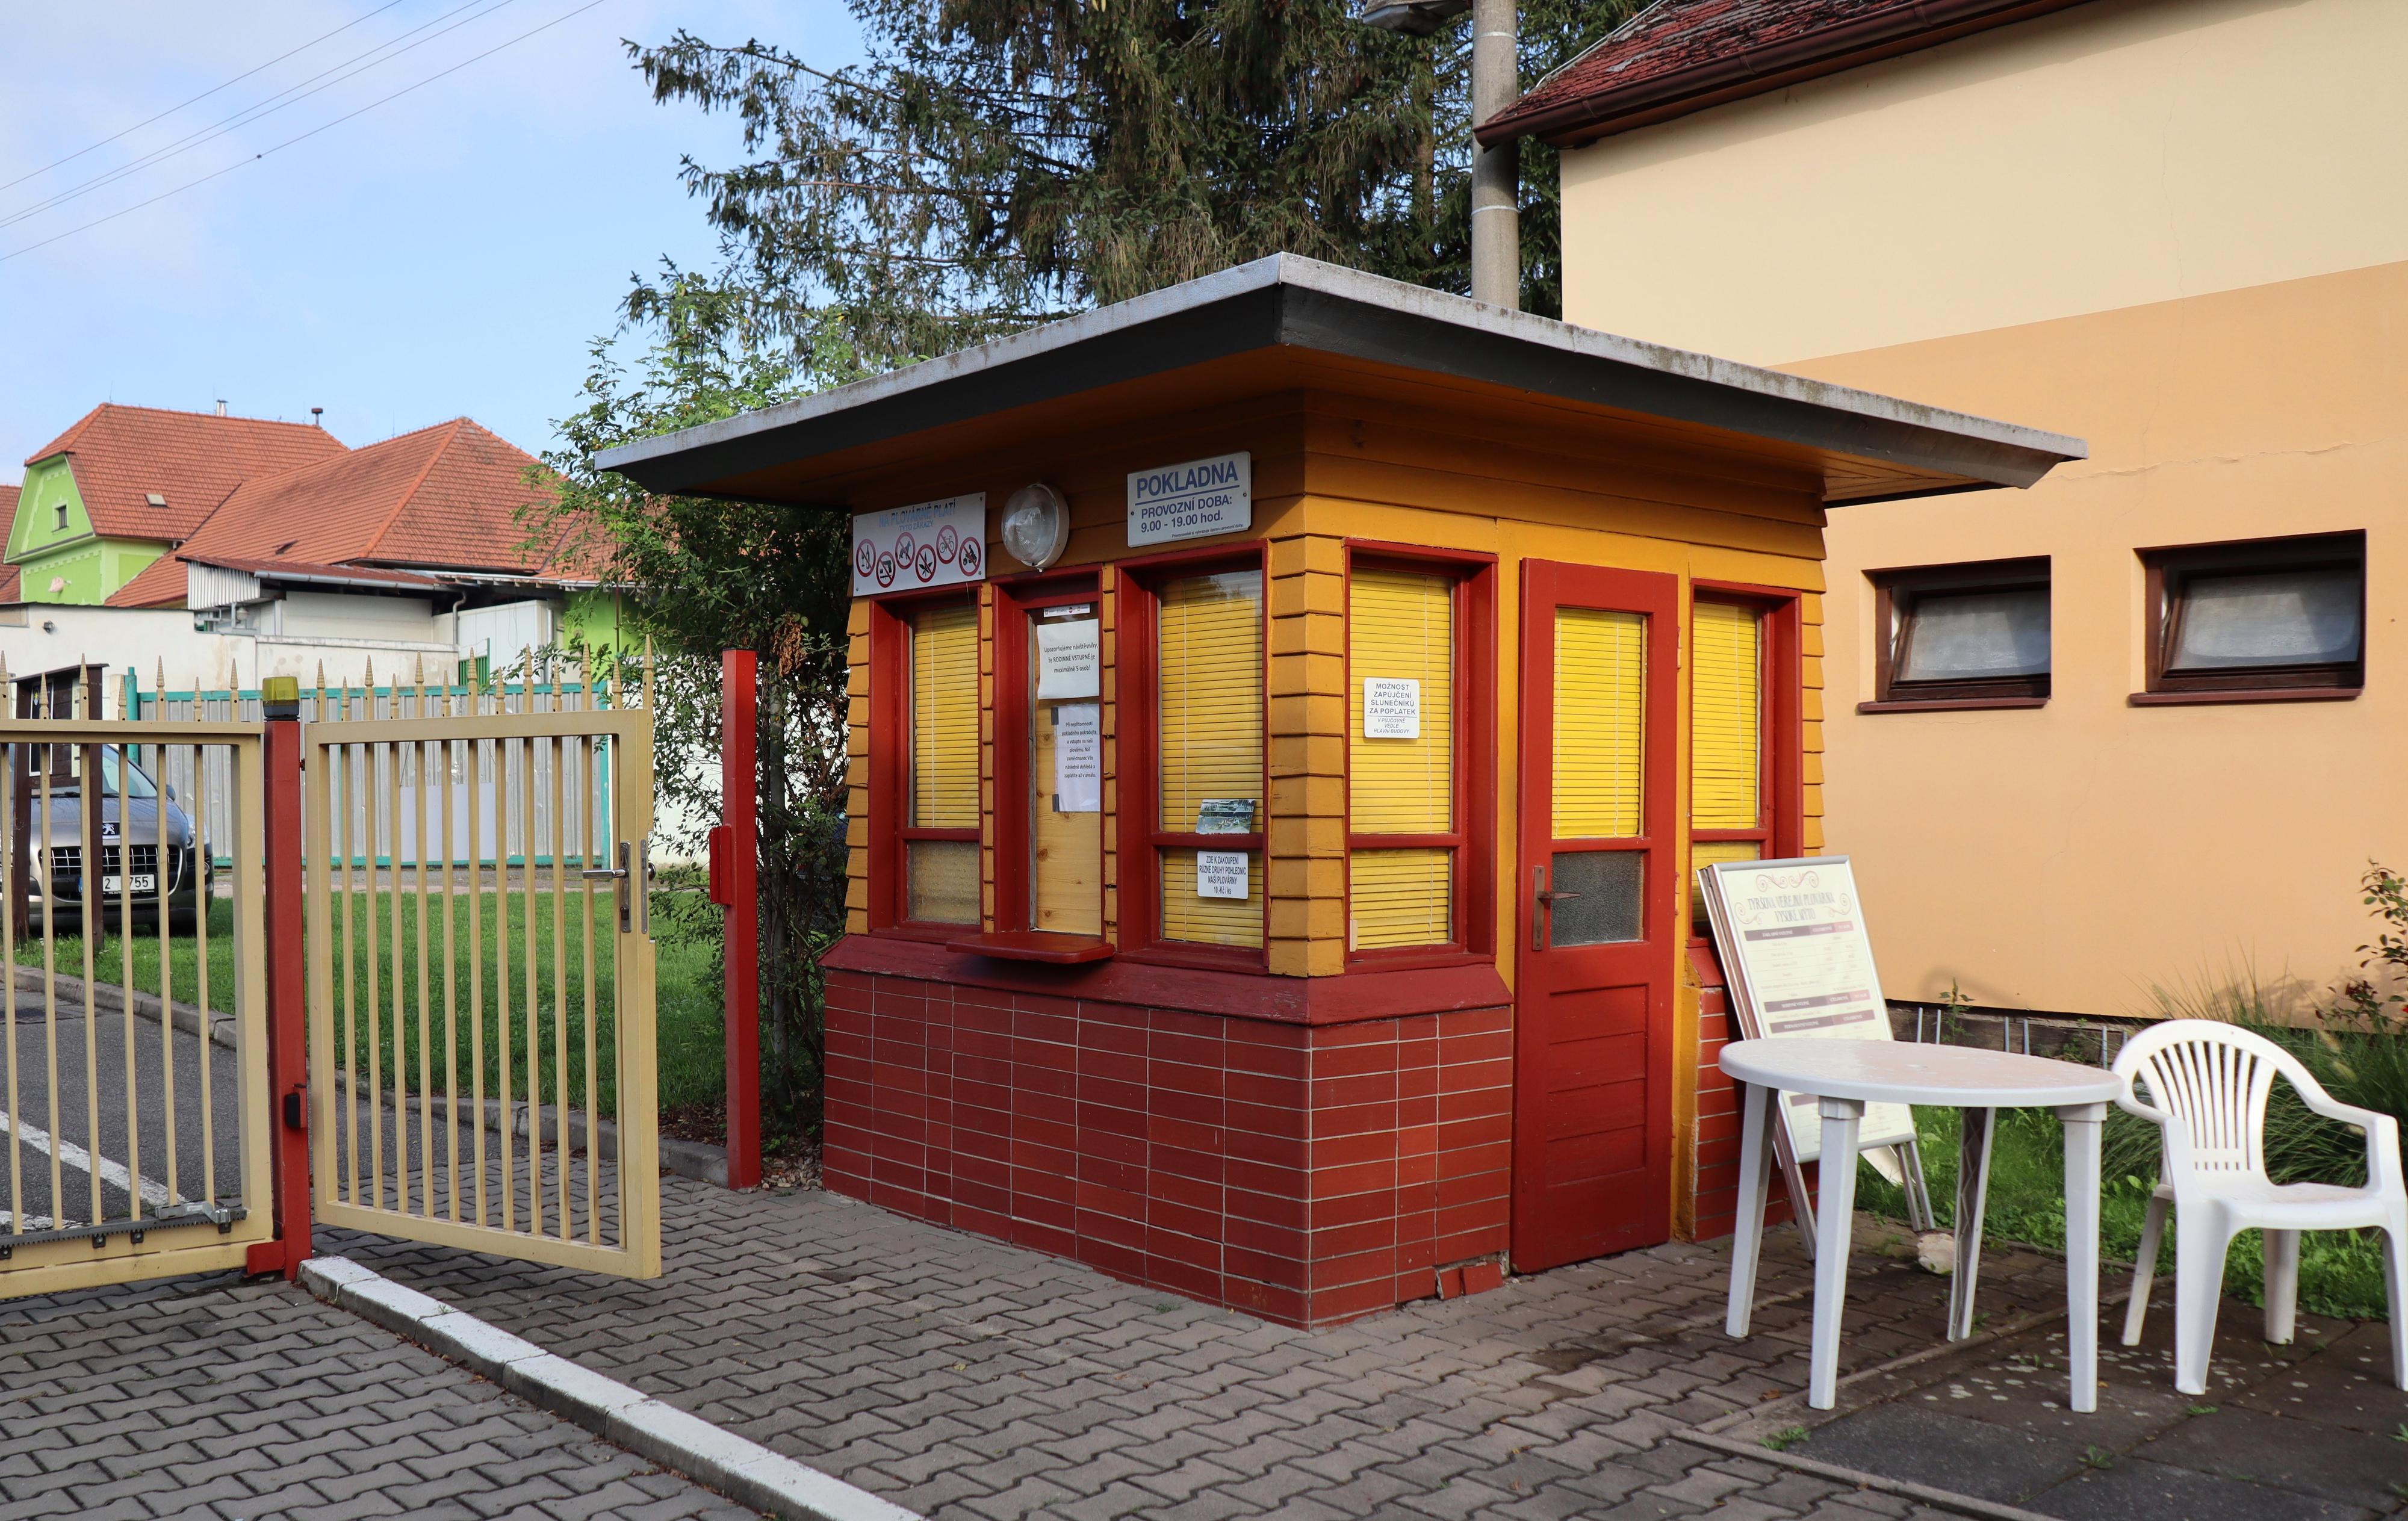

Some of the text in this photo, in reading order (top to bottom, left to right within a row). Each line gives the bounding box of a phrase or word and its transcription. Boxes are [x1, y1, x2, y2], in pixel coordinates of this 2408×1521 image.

[1137, 461, 1238, 499] POKLADNA
[1141, 494, 1232, 519] PROVOZNÍ DOBA:
[879, 498, 956, 527] NA PLOVÁRNĚ PLATÍ
[913, 520, 933, 530] ZÁKAZY
[1141, 520, 1161, 533] 9.00
[1171, 514, 1198, 528] 19.00
[1200, 510, 1223, 524] hod.
[1044, 645, 1072, 654] Upozorňujeme
[1072, 652, 1090, 661] VSTUPNÉ
[1376, 682, 1409, 690] MOŽNOST
[1218, 855, 1239, 864] ZAKOUPENÍ
[1199, 863, 1246, 875] RŮZNÉ DRUHY POHLEDNIC
[1208, 874, 1237, 885] NAŠÍ PLOVÁRNY
